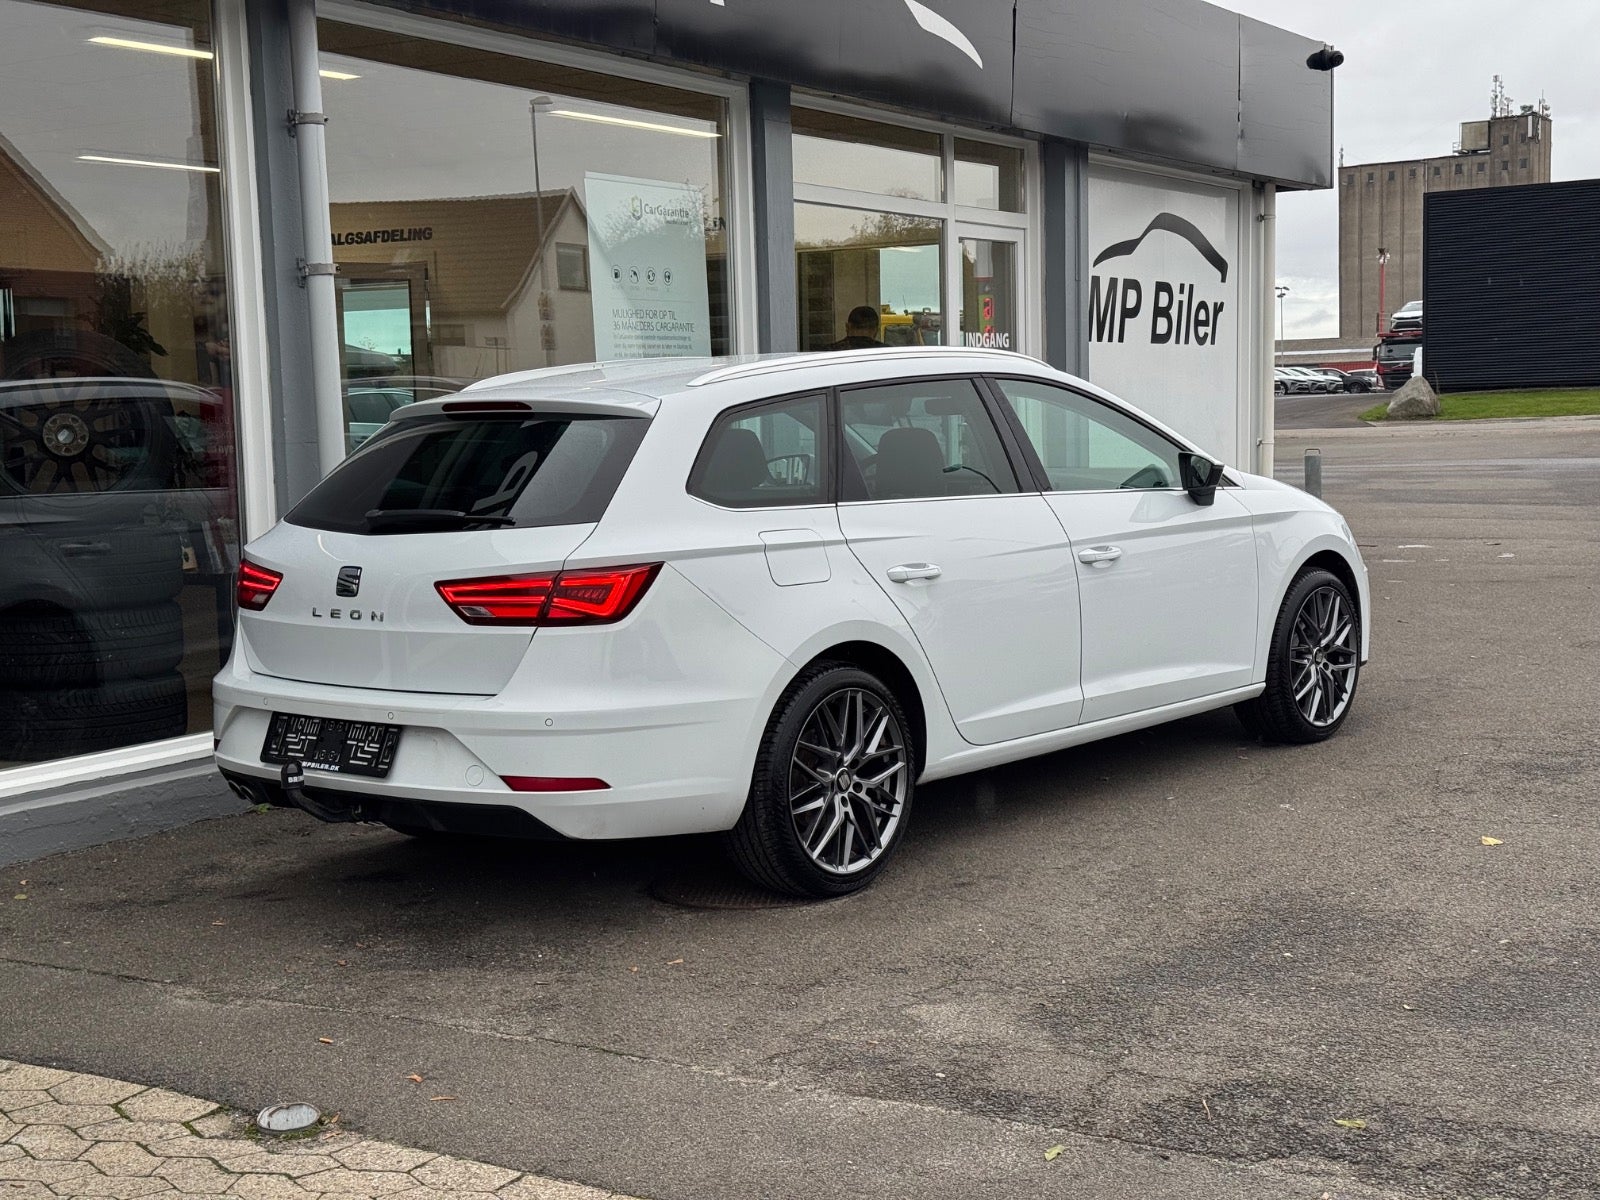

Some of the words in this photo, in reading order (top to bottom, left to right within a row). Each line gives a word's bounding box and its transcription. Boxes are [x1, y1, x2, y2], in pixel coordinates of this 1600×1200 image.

[644, 203, 690, 218] CarGarantie
[645, 309, 658, 320] FOR
[659, 310, 667, 320] OP
[668, 310, 677, 320] TIL
[1089, 275, 1142, 343] MP
[1150, 281, 1225, 346] Biler
[965, 331, 1010, 348] INDGANG
[312, 606, 384, 622] LEON
